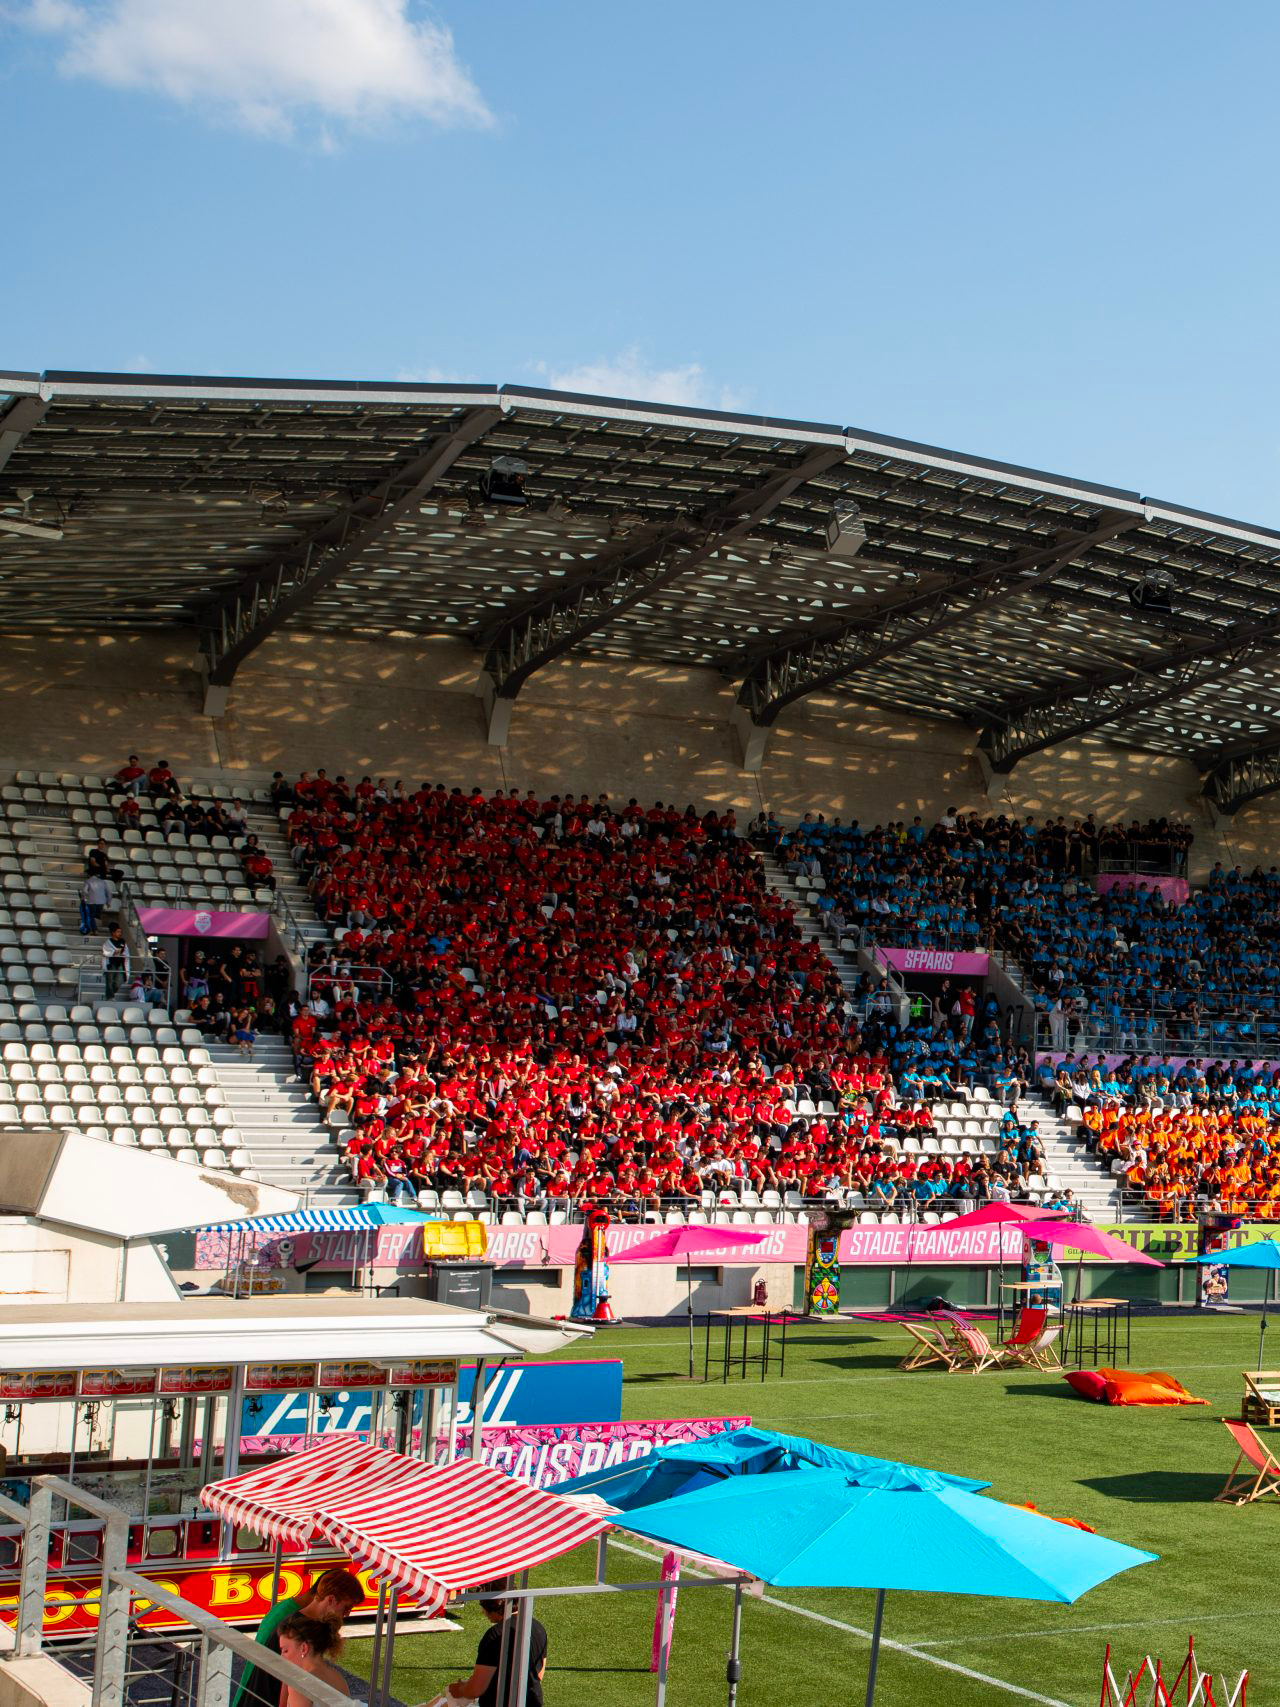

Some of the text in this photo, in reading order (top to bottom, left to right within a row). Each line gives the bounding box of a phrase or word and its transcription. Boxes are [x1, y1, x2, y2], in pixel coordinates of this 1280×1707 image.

[904, 950, 954, 971] SFPARIS
[309, 1232, 376, 1260] STADE
[486, 1232, 539, 1259] PARIS
[607, 1231, 645, 1256] OUS
[850, 1231, 904, 1255] STADE
[906, 1230, 986, 1257] FRANÇAIS
[988, 1230, 1023, 1255] PARI
[1107, 1229, 1249, 1253] GILBET
[161, 1367, 232, 1392] GIGA
[248, 1364, 315, 1389] GIGA
[256, 1370, 517, 1436] Airell
